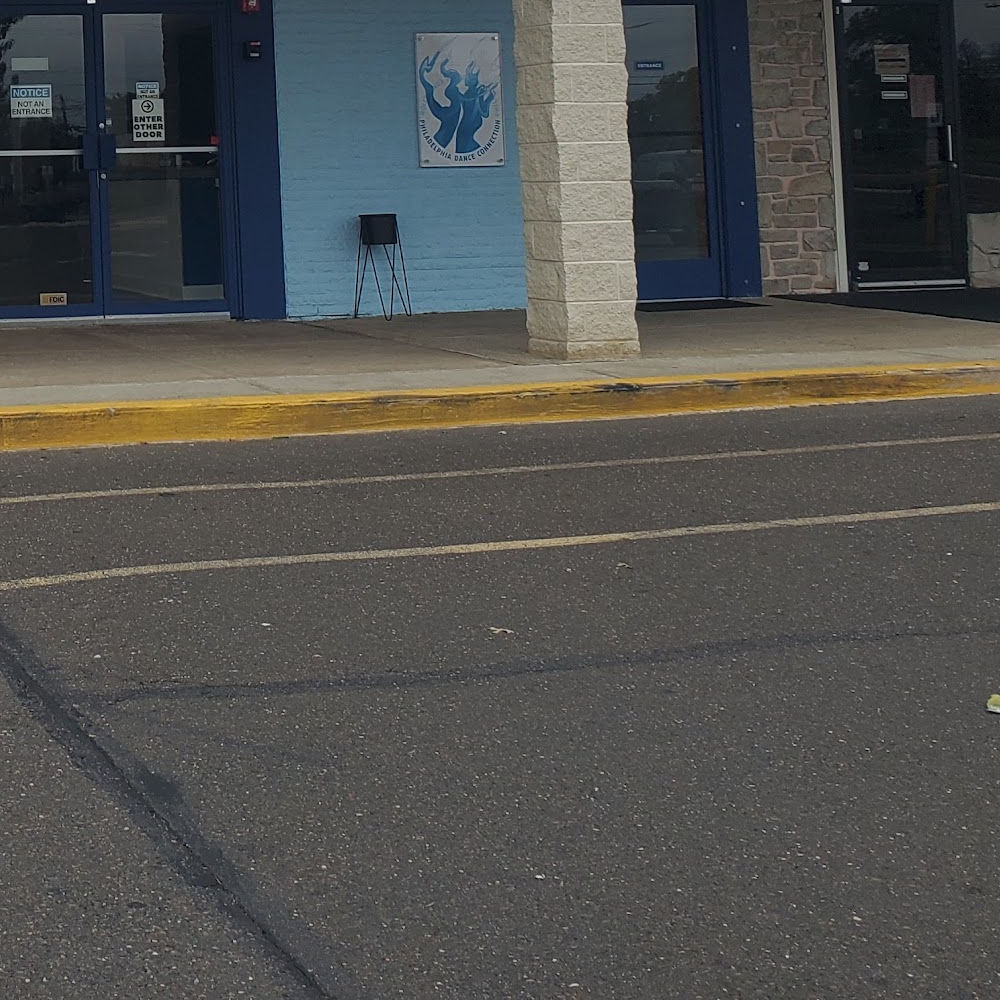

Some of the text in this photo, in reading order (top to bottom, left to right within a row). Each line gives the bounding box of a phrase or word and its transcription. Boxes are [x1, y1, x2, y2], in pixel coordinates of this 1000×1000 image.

[12, 88, 49, 98] NOTICE
[17, 100, 45, 108] NOT AN
[12, 108, 51, 116] ENTRANCE
[134, 115, 163, 123] ENTER
[134, 123, 164, 131] OTHER
[419, 119, 501, 162] PHILADELPHIA DANCE CONNECTION
